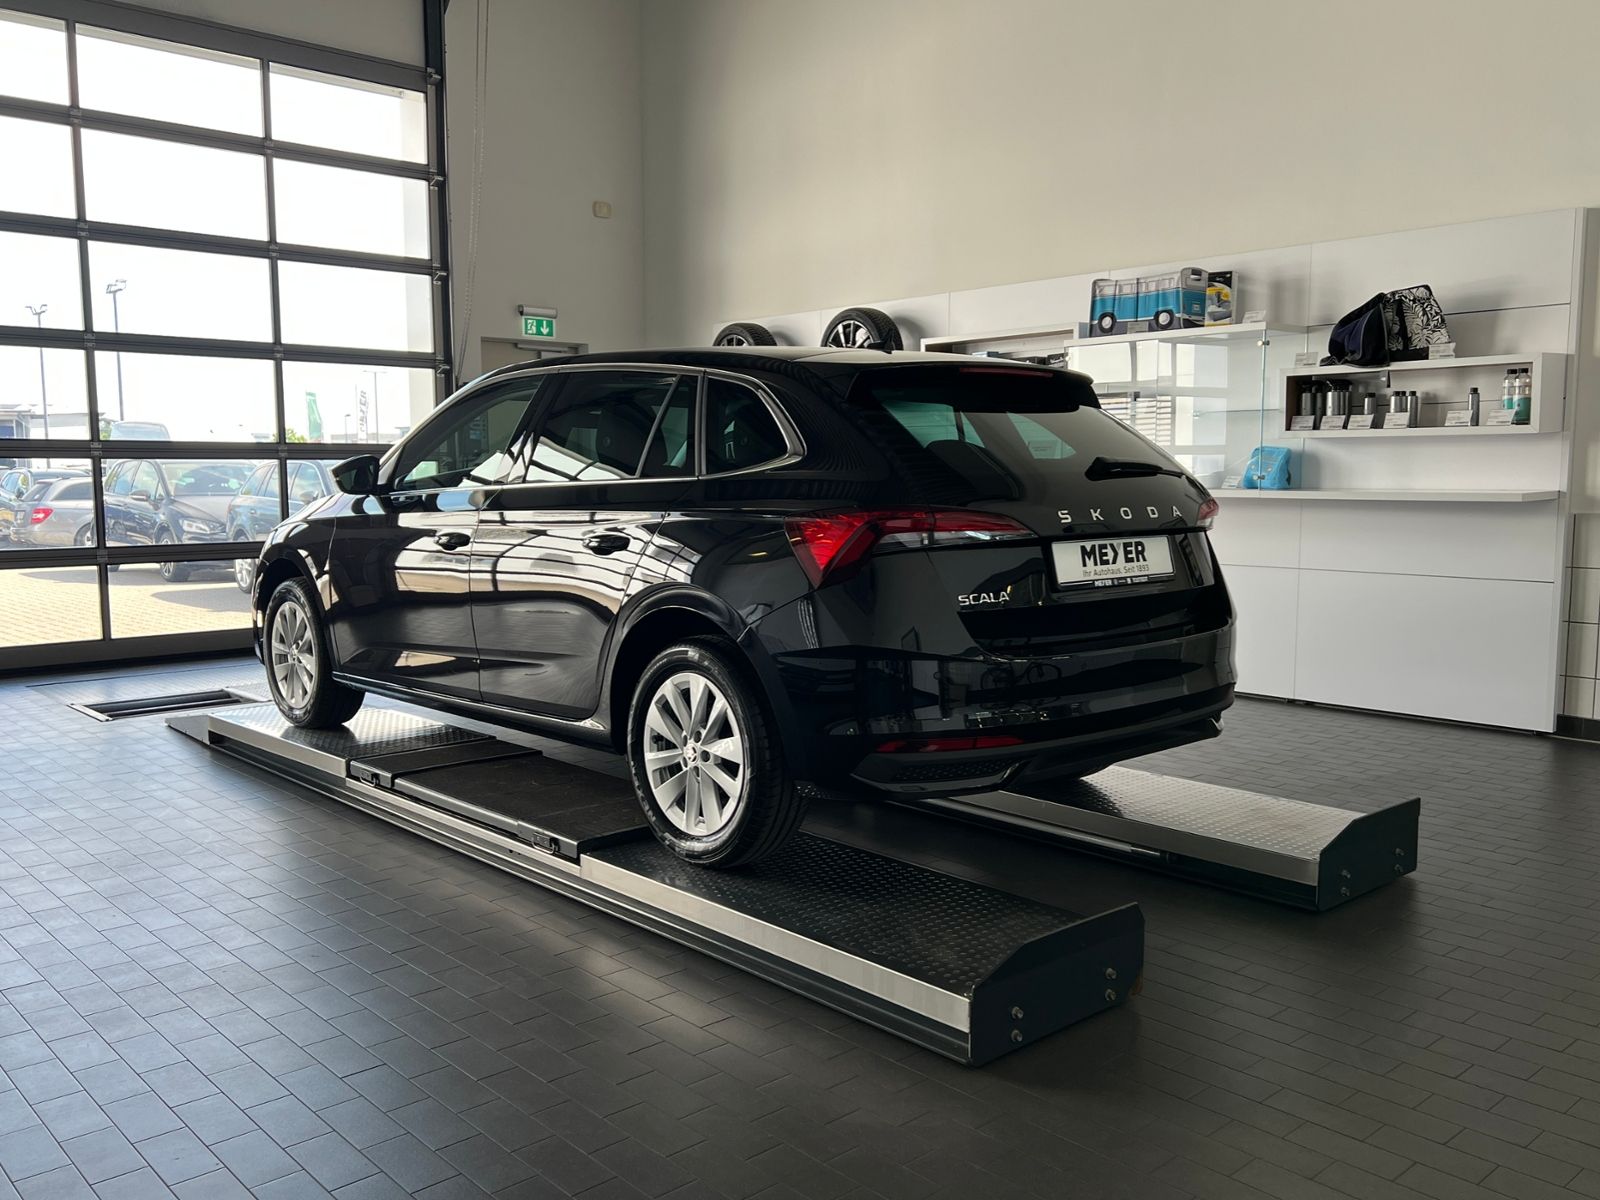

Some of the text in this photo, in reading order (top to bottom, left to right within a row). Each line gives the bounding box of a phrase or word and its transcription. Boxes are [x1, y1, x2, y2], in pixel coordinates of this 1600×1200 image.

[1080, 540, 1147, 568] MEYER
[1082, 569, 1092, 577] Ihr
[1123, 566, 1136, 574] Seit
[1136, 564, 1150, 573] 1893
[958, 591, 1009, 606] SCALA
